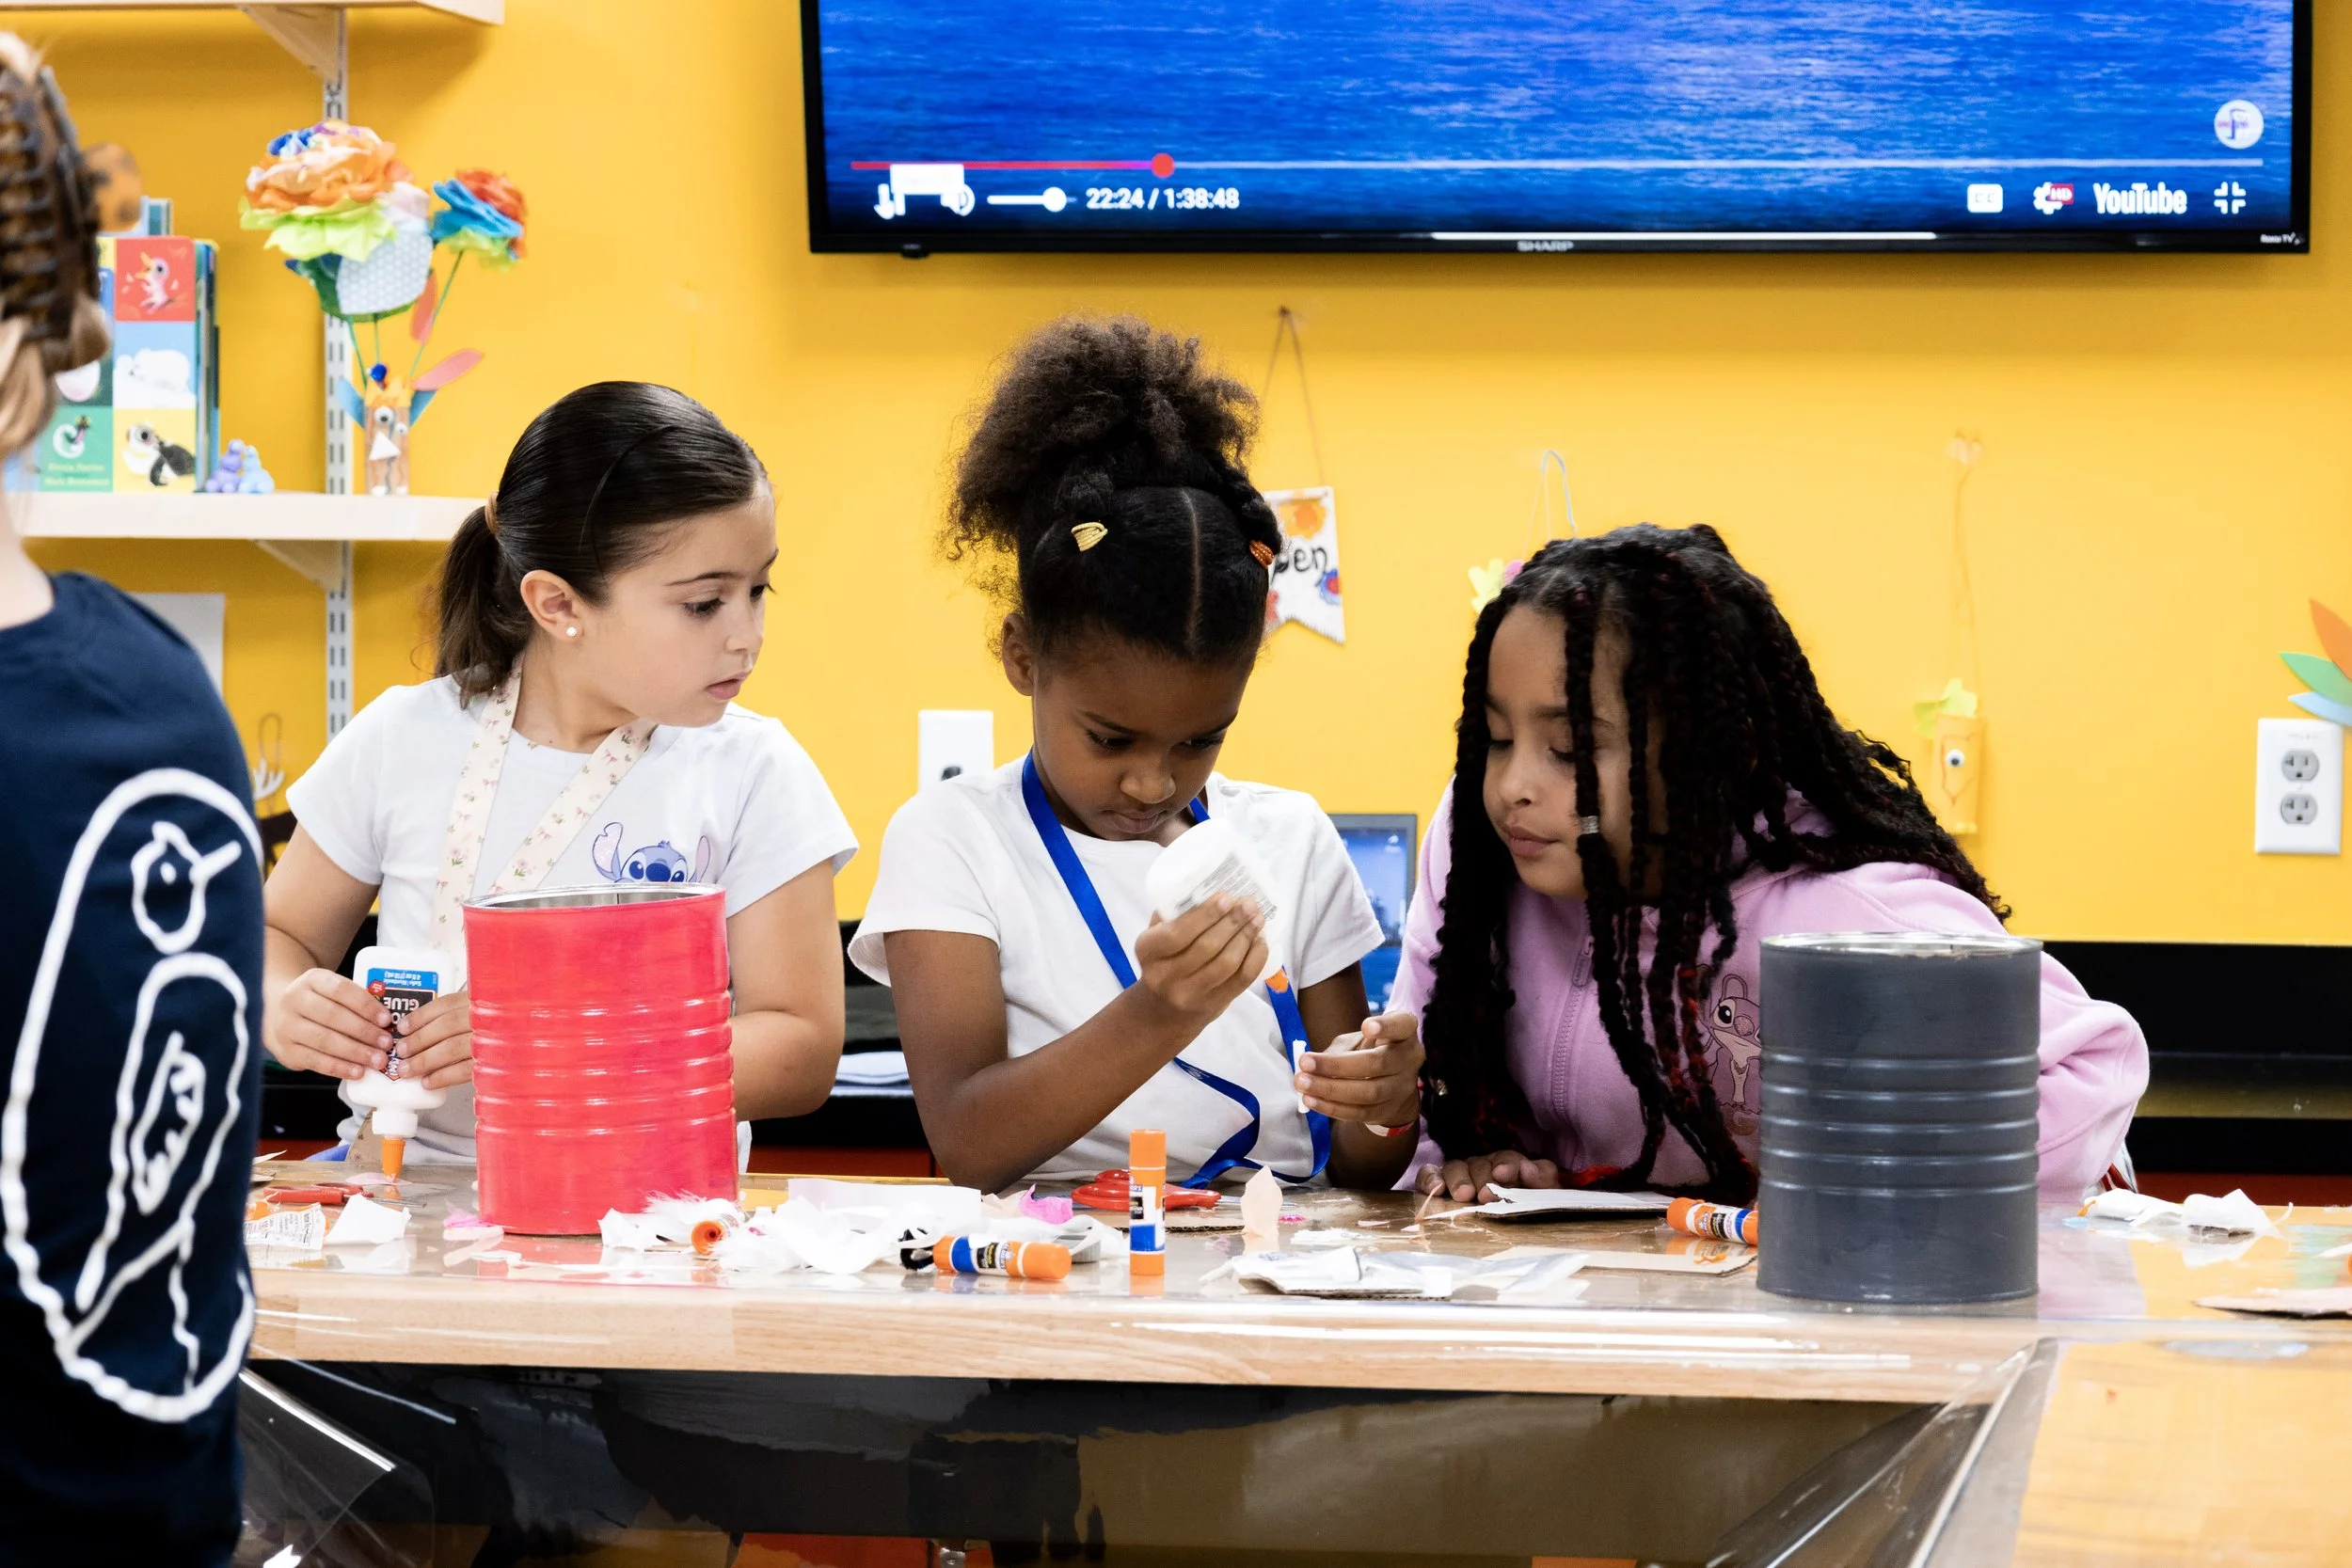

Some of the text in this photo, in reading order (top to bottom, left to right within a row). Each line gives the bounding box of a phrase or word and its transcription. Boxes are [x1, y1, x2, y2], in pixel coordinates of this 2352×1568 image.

[1086, 187, 1240, 210] 22:24 / 1:38:48
[2092, 182, 2187, 214] YouTube
[383, 997, 420, 1011] GLUE
